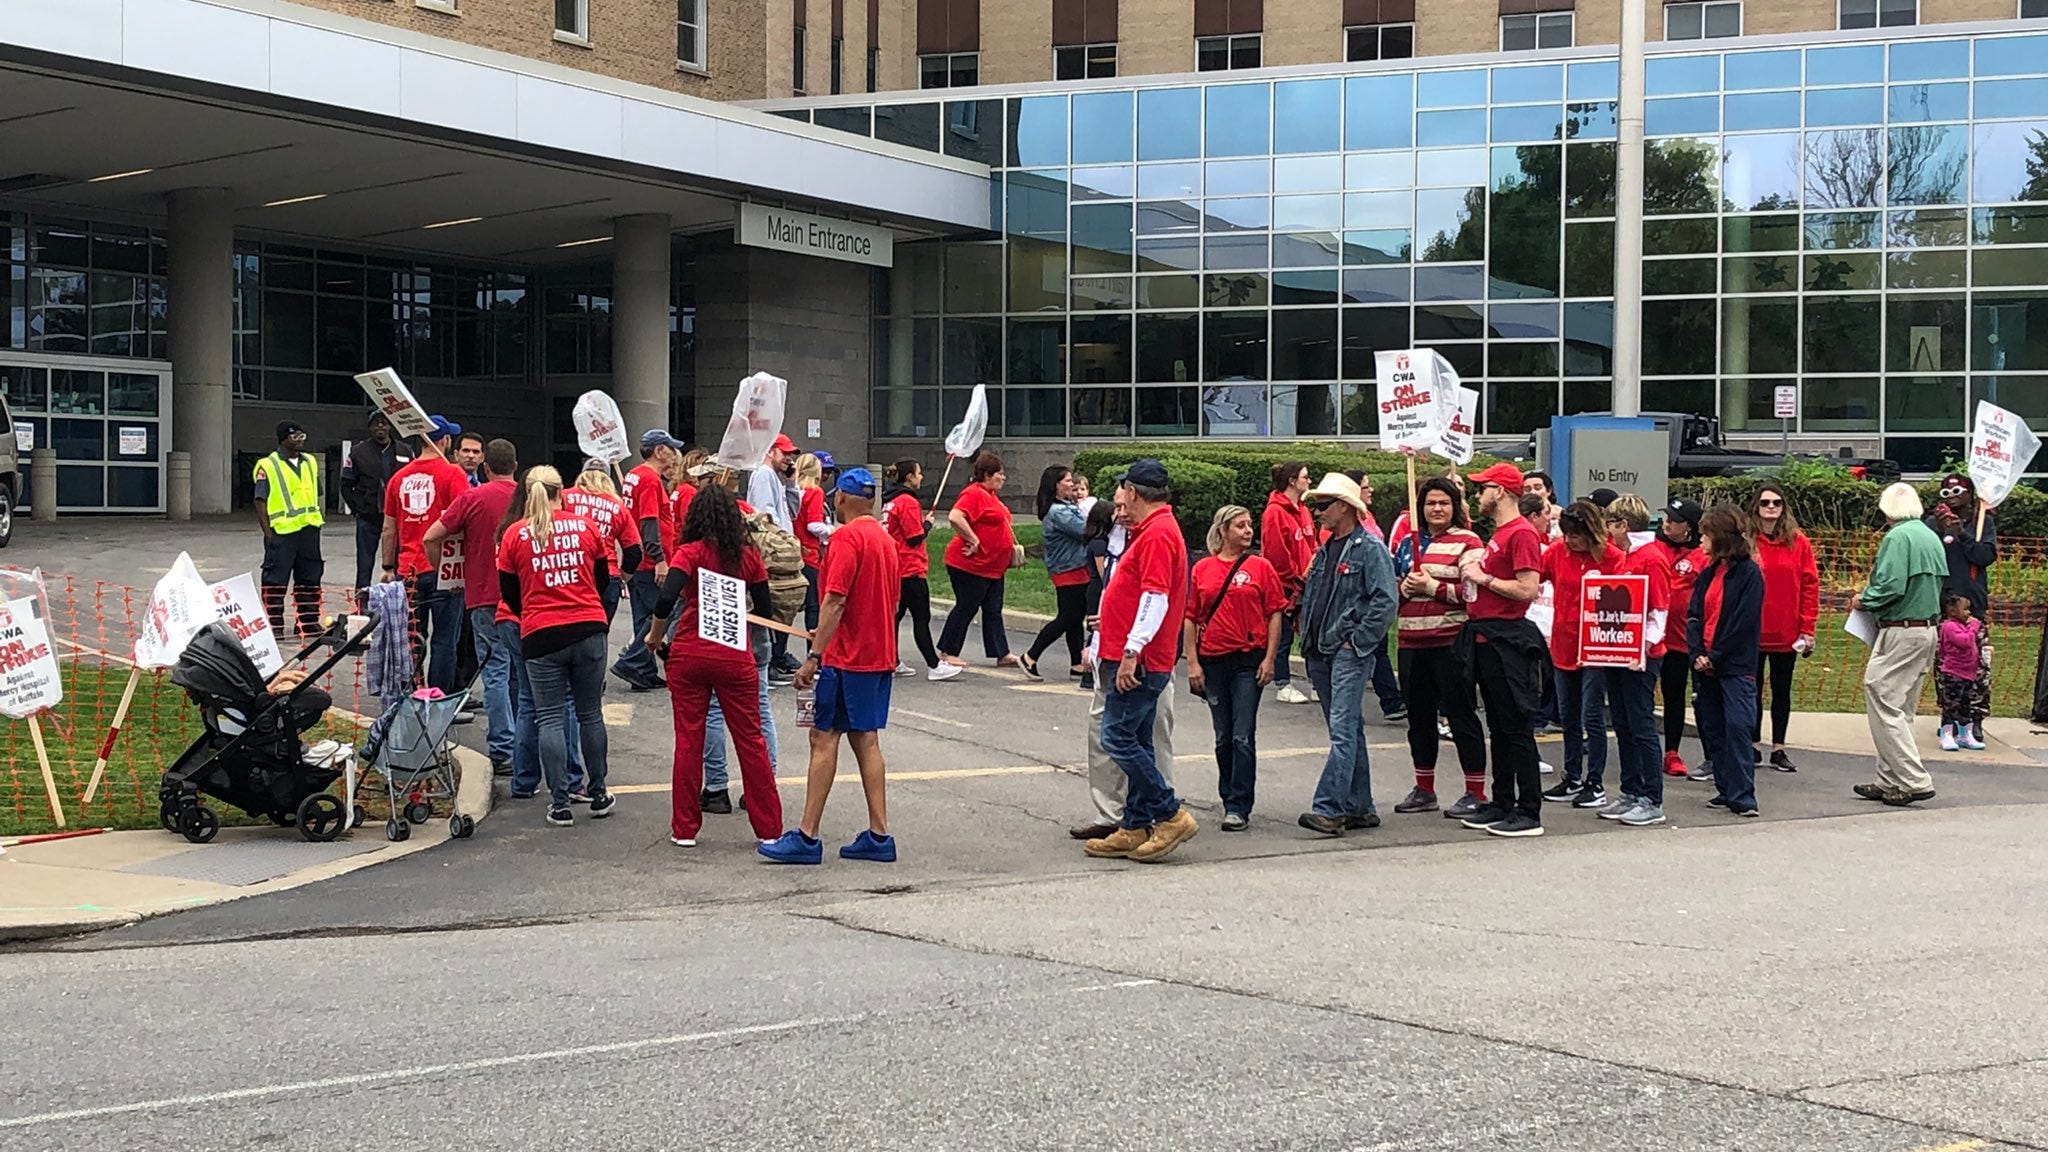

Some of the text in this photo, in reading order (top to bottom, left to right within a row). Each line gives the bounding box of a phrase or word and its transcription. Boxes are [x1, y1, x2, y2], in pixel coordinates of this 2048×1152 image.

[768, 215, 871, 256] Main Entrance
[1392, 372, 1416, 383] CWA
[1393, 383, 1415, 399] ON
[1381, 391, 1432, 414] STRIKE
[1396, 412, 1417, 421] Against
[1387, 420, 1428, 431] Mercy Hospital
[1986, 439, 2002, 451] ON
[1974, 446, 2011, 463] STRIKE
[1588, 468, 1639, 485] No Entry
[404, 480, 431, 492] CWA
[567, 493, 621, 514] STANDING
[574, 505, 612, 524] UP FOR
[553, 533, 580, 551] FOR
[531, 551, 585, 572] PATIENT
[545, 568, 579, 587] CARE
[1587, 586, 1601, 600] WE
[701, 572, 720, 639] SAFE STAFFING
[720, 578, 738, 645] SAVES LIVES
[1589, 626, 1634, 644] Workers
[0, 642, 50, 675] TRIKE
[6, 670, 35, 686] Against
[20, 676, 50, 692] Hospital
[18, 691, 44, 704] Buffalo
